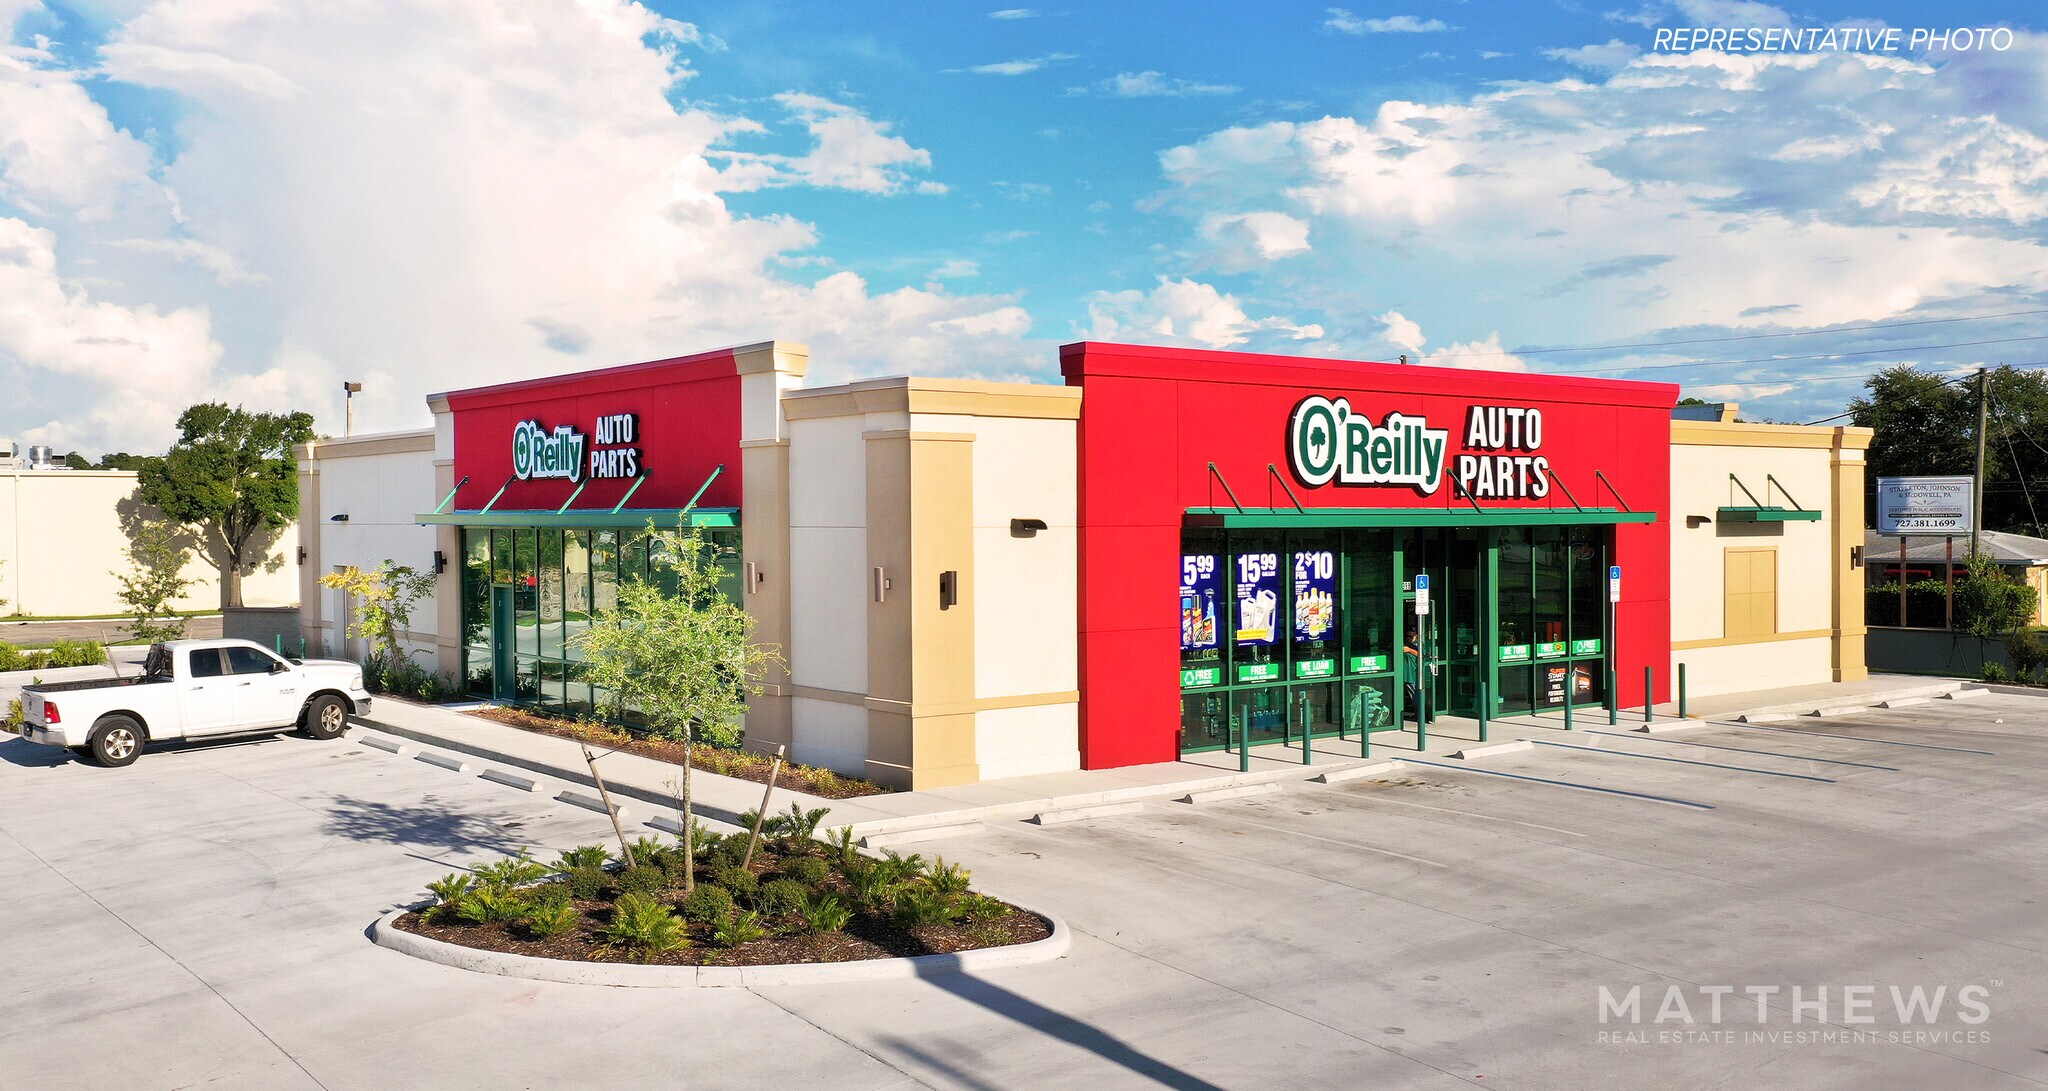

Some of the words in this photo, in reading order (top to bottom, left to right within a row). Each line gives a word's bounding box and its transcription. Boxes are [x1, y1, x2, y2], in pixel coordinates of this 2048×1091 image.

[595, 413, 633, 445] AUTO
[1468, 405, 1542, 450] AUTO
[513, 426, 580, 478] O'Reilly
[1299, 404, 1443, 486] O'Reilly
[591, 448, 637, 478] PARTS
[1460, 455, 1549, 498] PARTS
[1295, 571, 1308, 580] FOR
[1195, 669, 1213, 680] FREE
[1250, 665, 1267, 675] FREE
[1300, 662, 1311, 671] WE
[1312, 660, 1329, 671] LOAN
[1360, 656, 1377, 667] FREE
